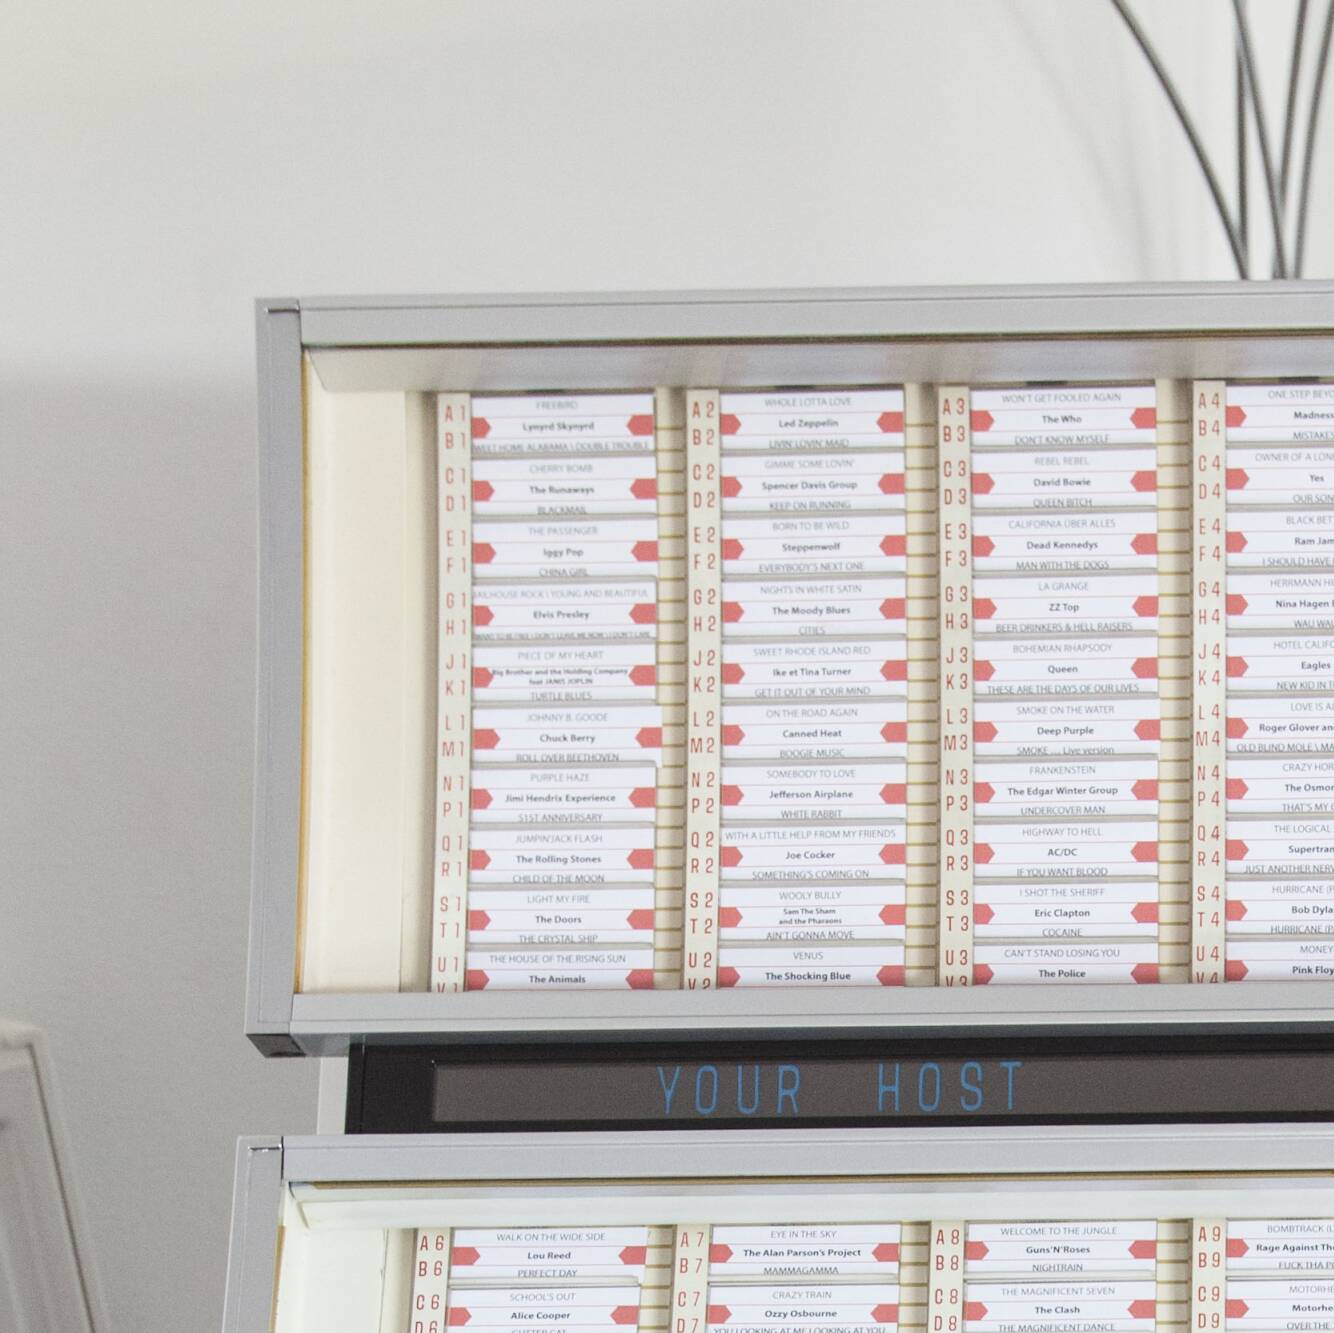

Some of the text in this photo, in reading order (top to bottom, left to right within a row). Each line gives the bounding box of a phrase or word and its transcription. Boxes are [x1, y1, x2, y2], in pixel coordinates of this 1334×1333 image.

[1293, 410, 1334, 419] Madness
[778, 418, 839, 429] Led Zeppelin
[781, 541, 841, 553] Steppenwolf
[771, 605, 851, 617] The Moody Blues
[1047, 664, 1079, 675] Queen
[782, 729, 842, 738] Canned Heat
[1036, 725, 1095, 737] Deep Purple
[539, 733, 596, 744] Chuck Berry
[769, 789, 853, 800] Jefferson Airplane
[1007, 785, 1119, 798] The Edgar Winter Group
[785, 850, 836, 860] Joe Cocker
[1047, 847, 1078, 857] AC/DC
[516, 854, 602, 866] The Rolling Stones
[1034, 908, 1091, 919] Eric Clapton
[1291, 905, 1311, 914] Bob
[792, 951, 824, 961] VENUS
[1038, 969, 1087, 978] The Police
[1292, 965, 1314, 974] Pink
[529, 975, 586, 984] The Animals
[765, 971, 851, 983] The Shocking Blue
[657, 1060, 1023, 1115] YOUR HOST
[770, 1230, 838, 1239] EYE IN THE SKY
[743, 1249, 761, 1257] The
[762, 1248, 785, 1257] Alan
[827, 1248, 861, 1258] Project
[510, 1311, 571, 1321] Alice Cooper
[764, 1309, 838, 1320] Ozzy Osbourne
